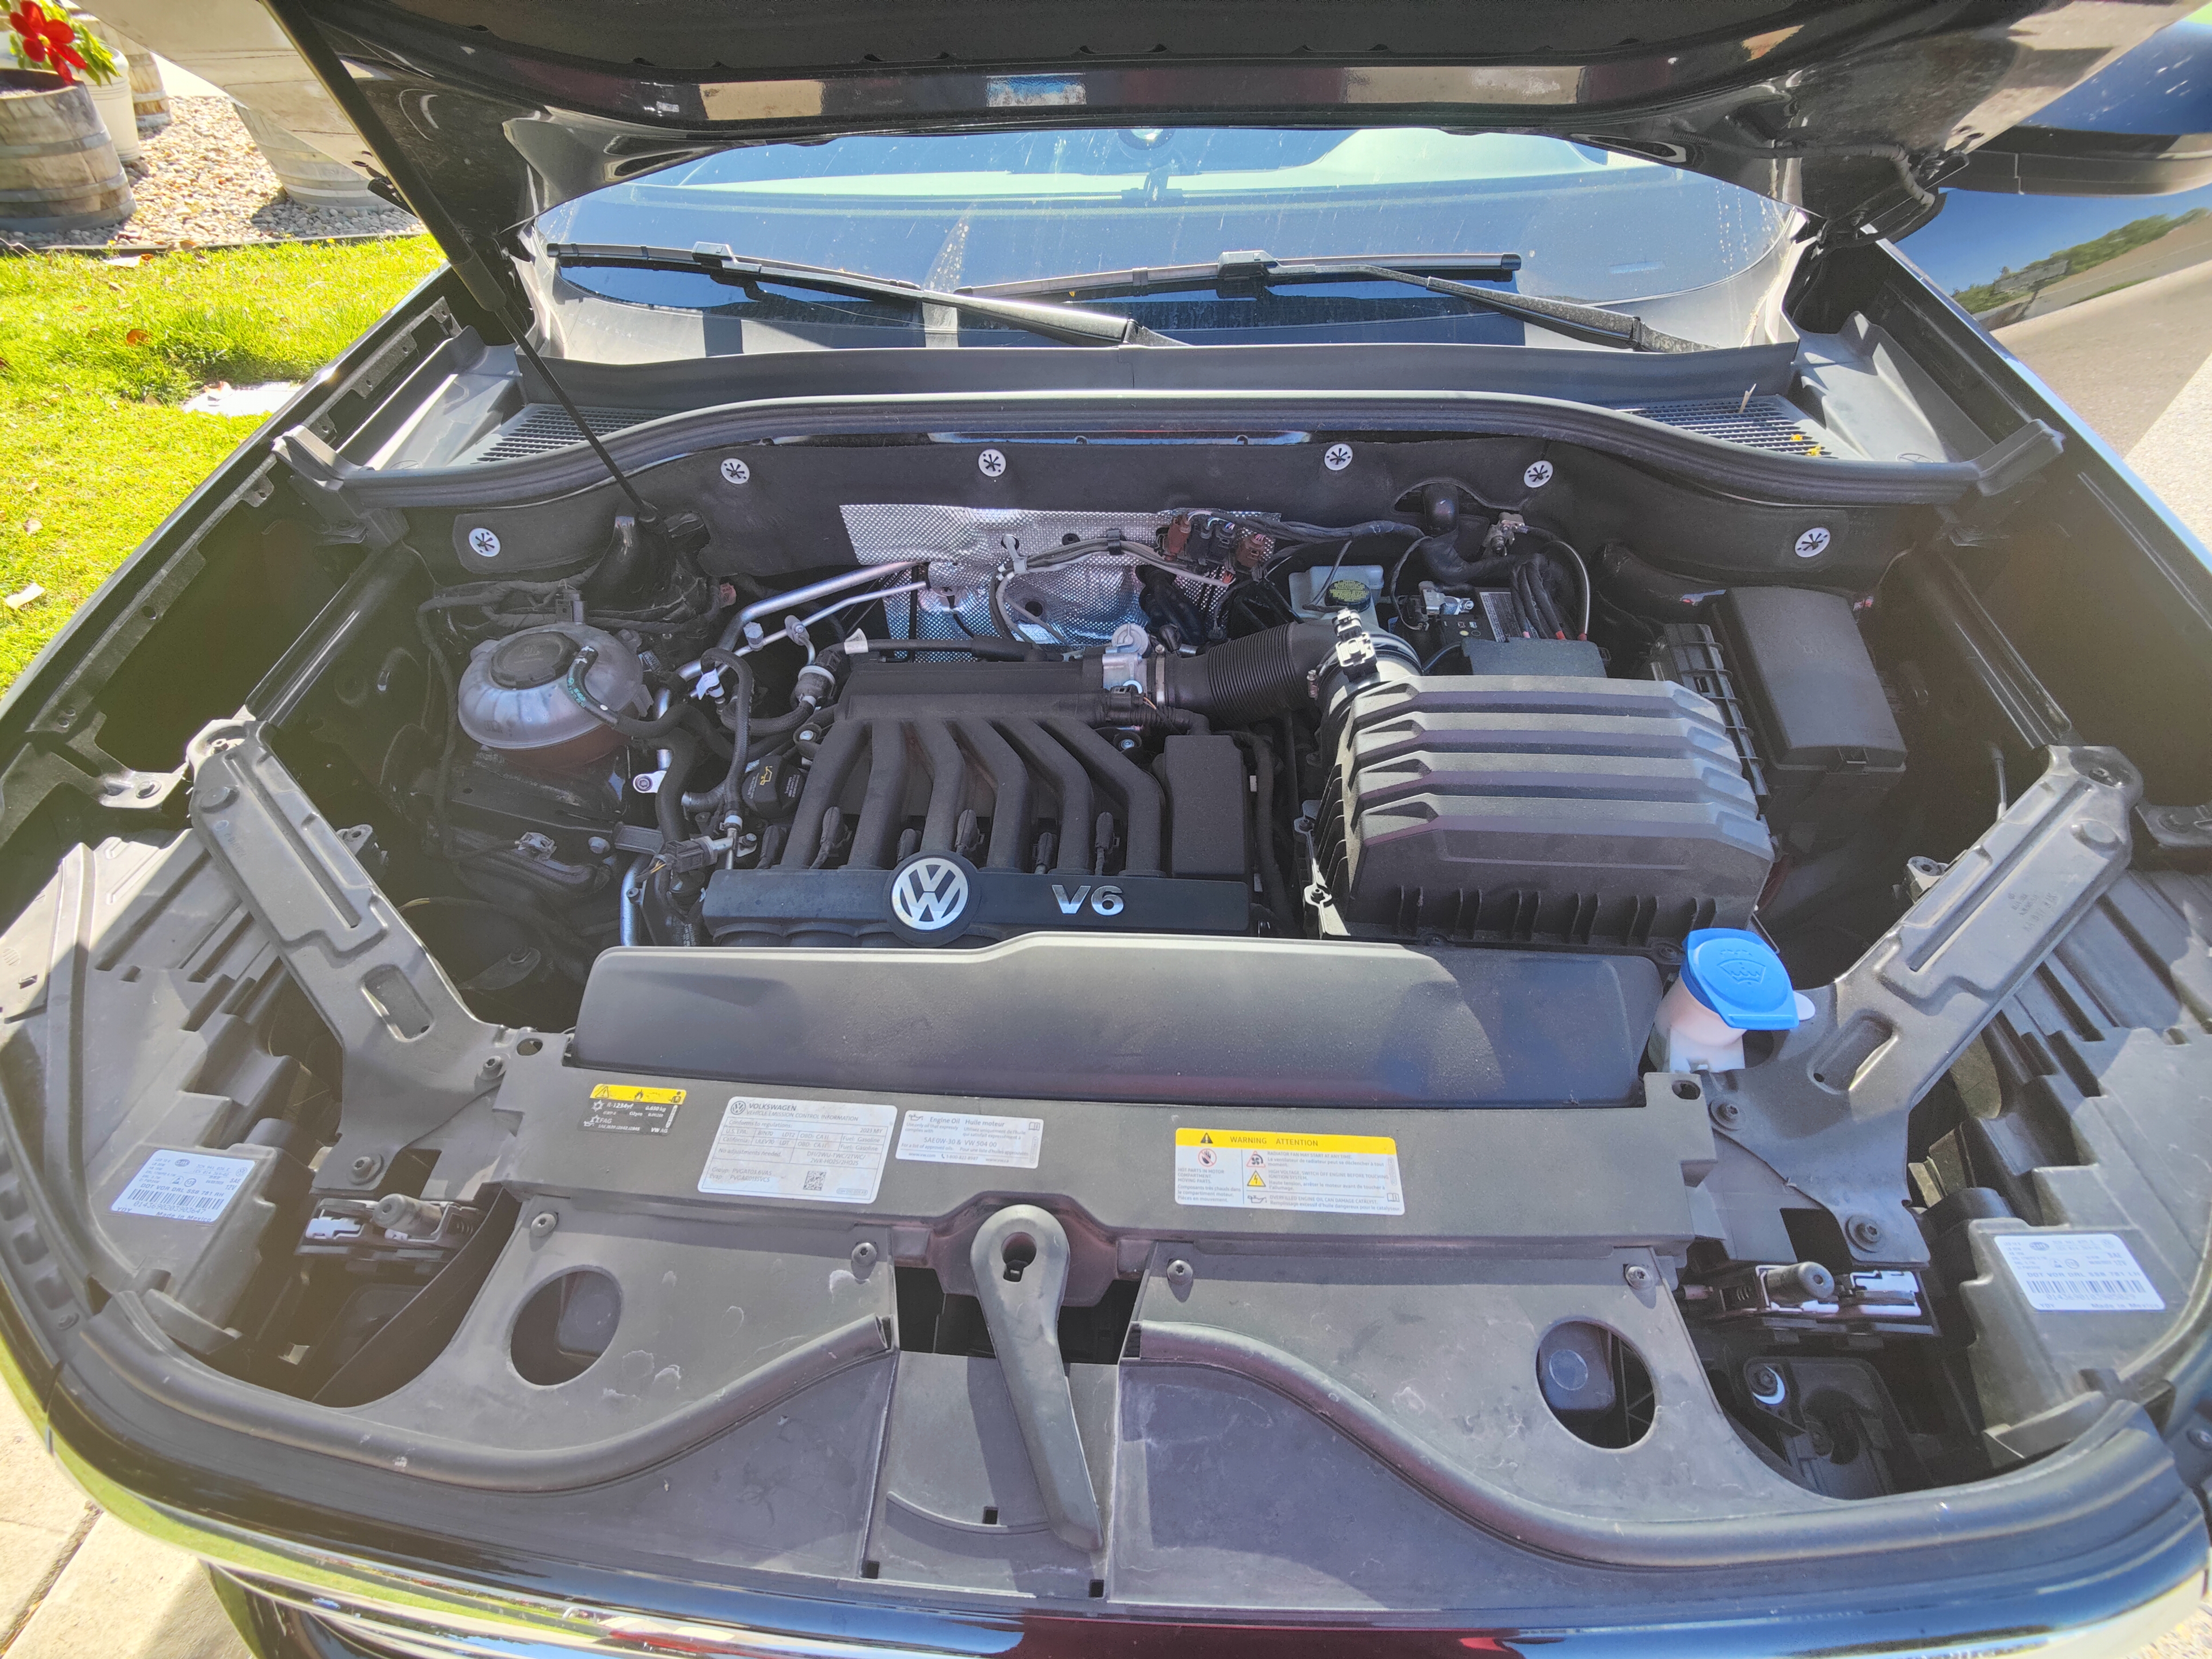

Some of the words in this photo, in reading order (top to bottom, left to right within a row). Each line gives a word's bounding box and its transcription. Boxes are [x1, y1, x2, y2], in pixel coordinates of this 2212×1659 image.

[1051, 885, 1124, 916] V6
[749, 1103, 797, 1111] VOLKSWAGEN
[1276, 1138, 1318, 1146] ATTENTION
